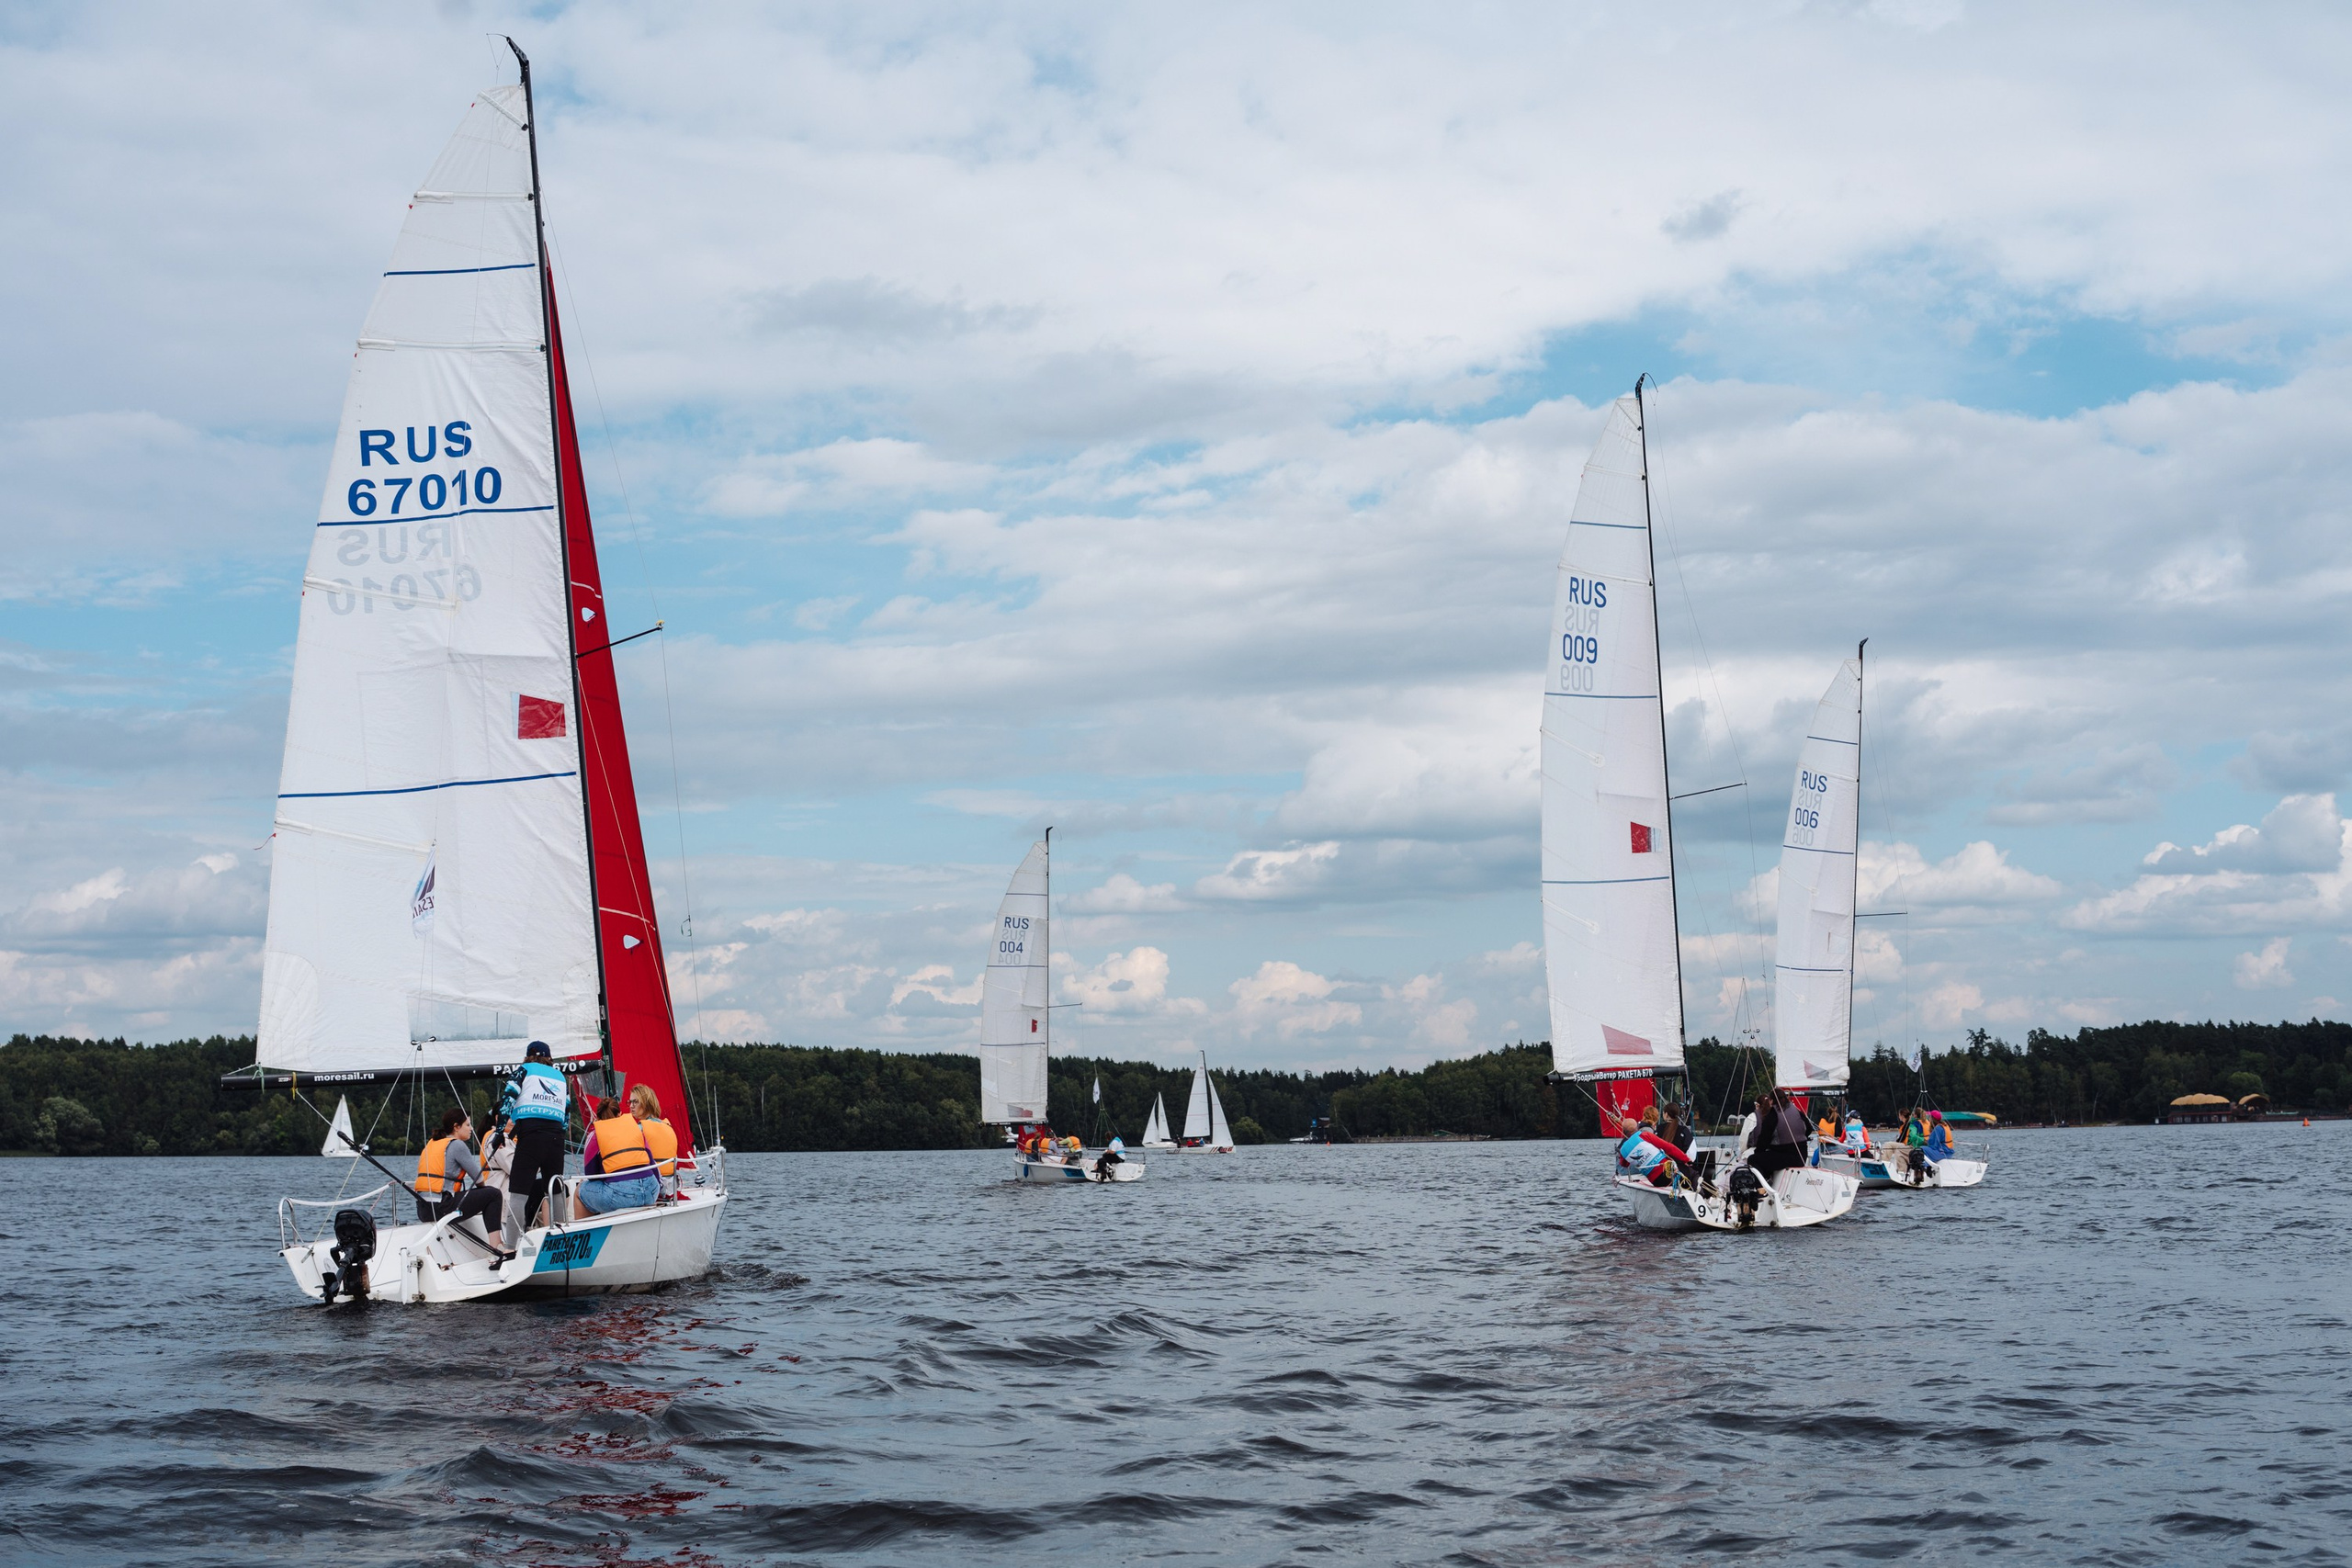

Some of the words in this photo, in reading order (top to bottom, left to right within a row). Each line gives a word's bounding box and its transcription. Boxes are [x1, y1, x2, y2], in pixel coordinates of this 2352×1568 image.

[359, 420, 473, 467] RUS
[347, 466, 503, 516] 67010
[1568, 576, 1607, 608] RUS
[1562, 633, 1598, 664] 009
[1801, 770, 1828, 793] RUS
[1794, 807, 1819, 829] 006
[1003, 916, 1030, 930] RUS
[1000, 941, 1023, 953] 004
[314, 1071, 375, 1082] moresail.ru
[551, 1061, 577, 1073] 670
[1697, 1204, 1707, 1218] 9
